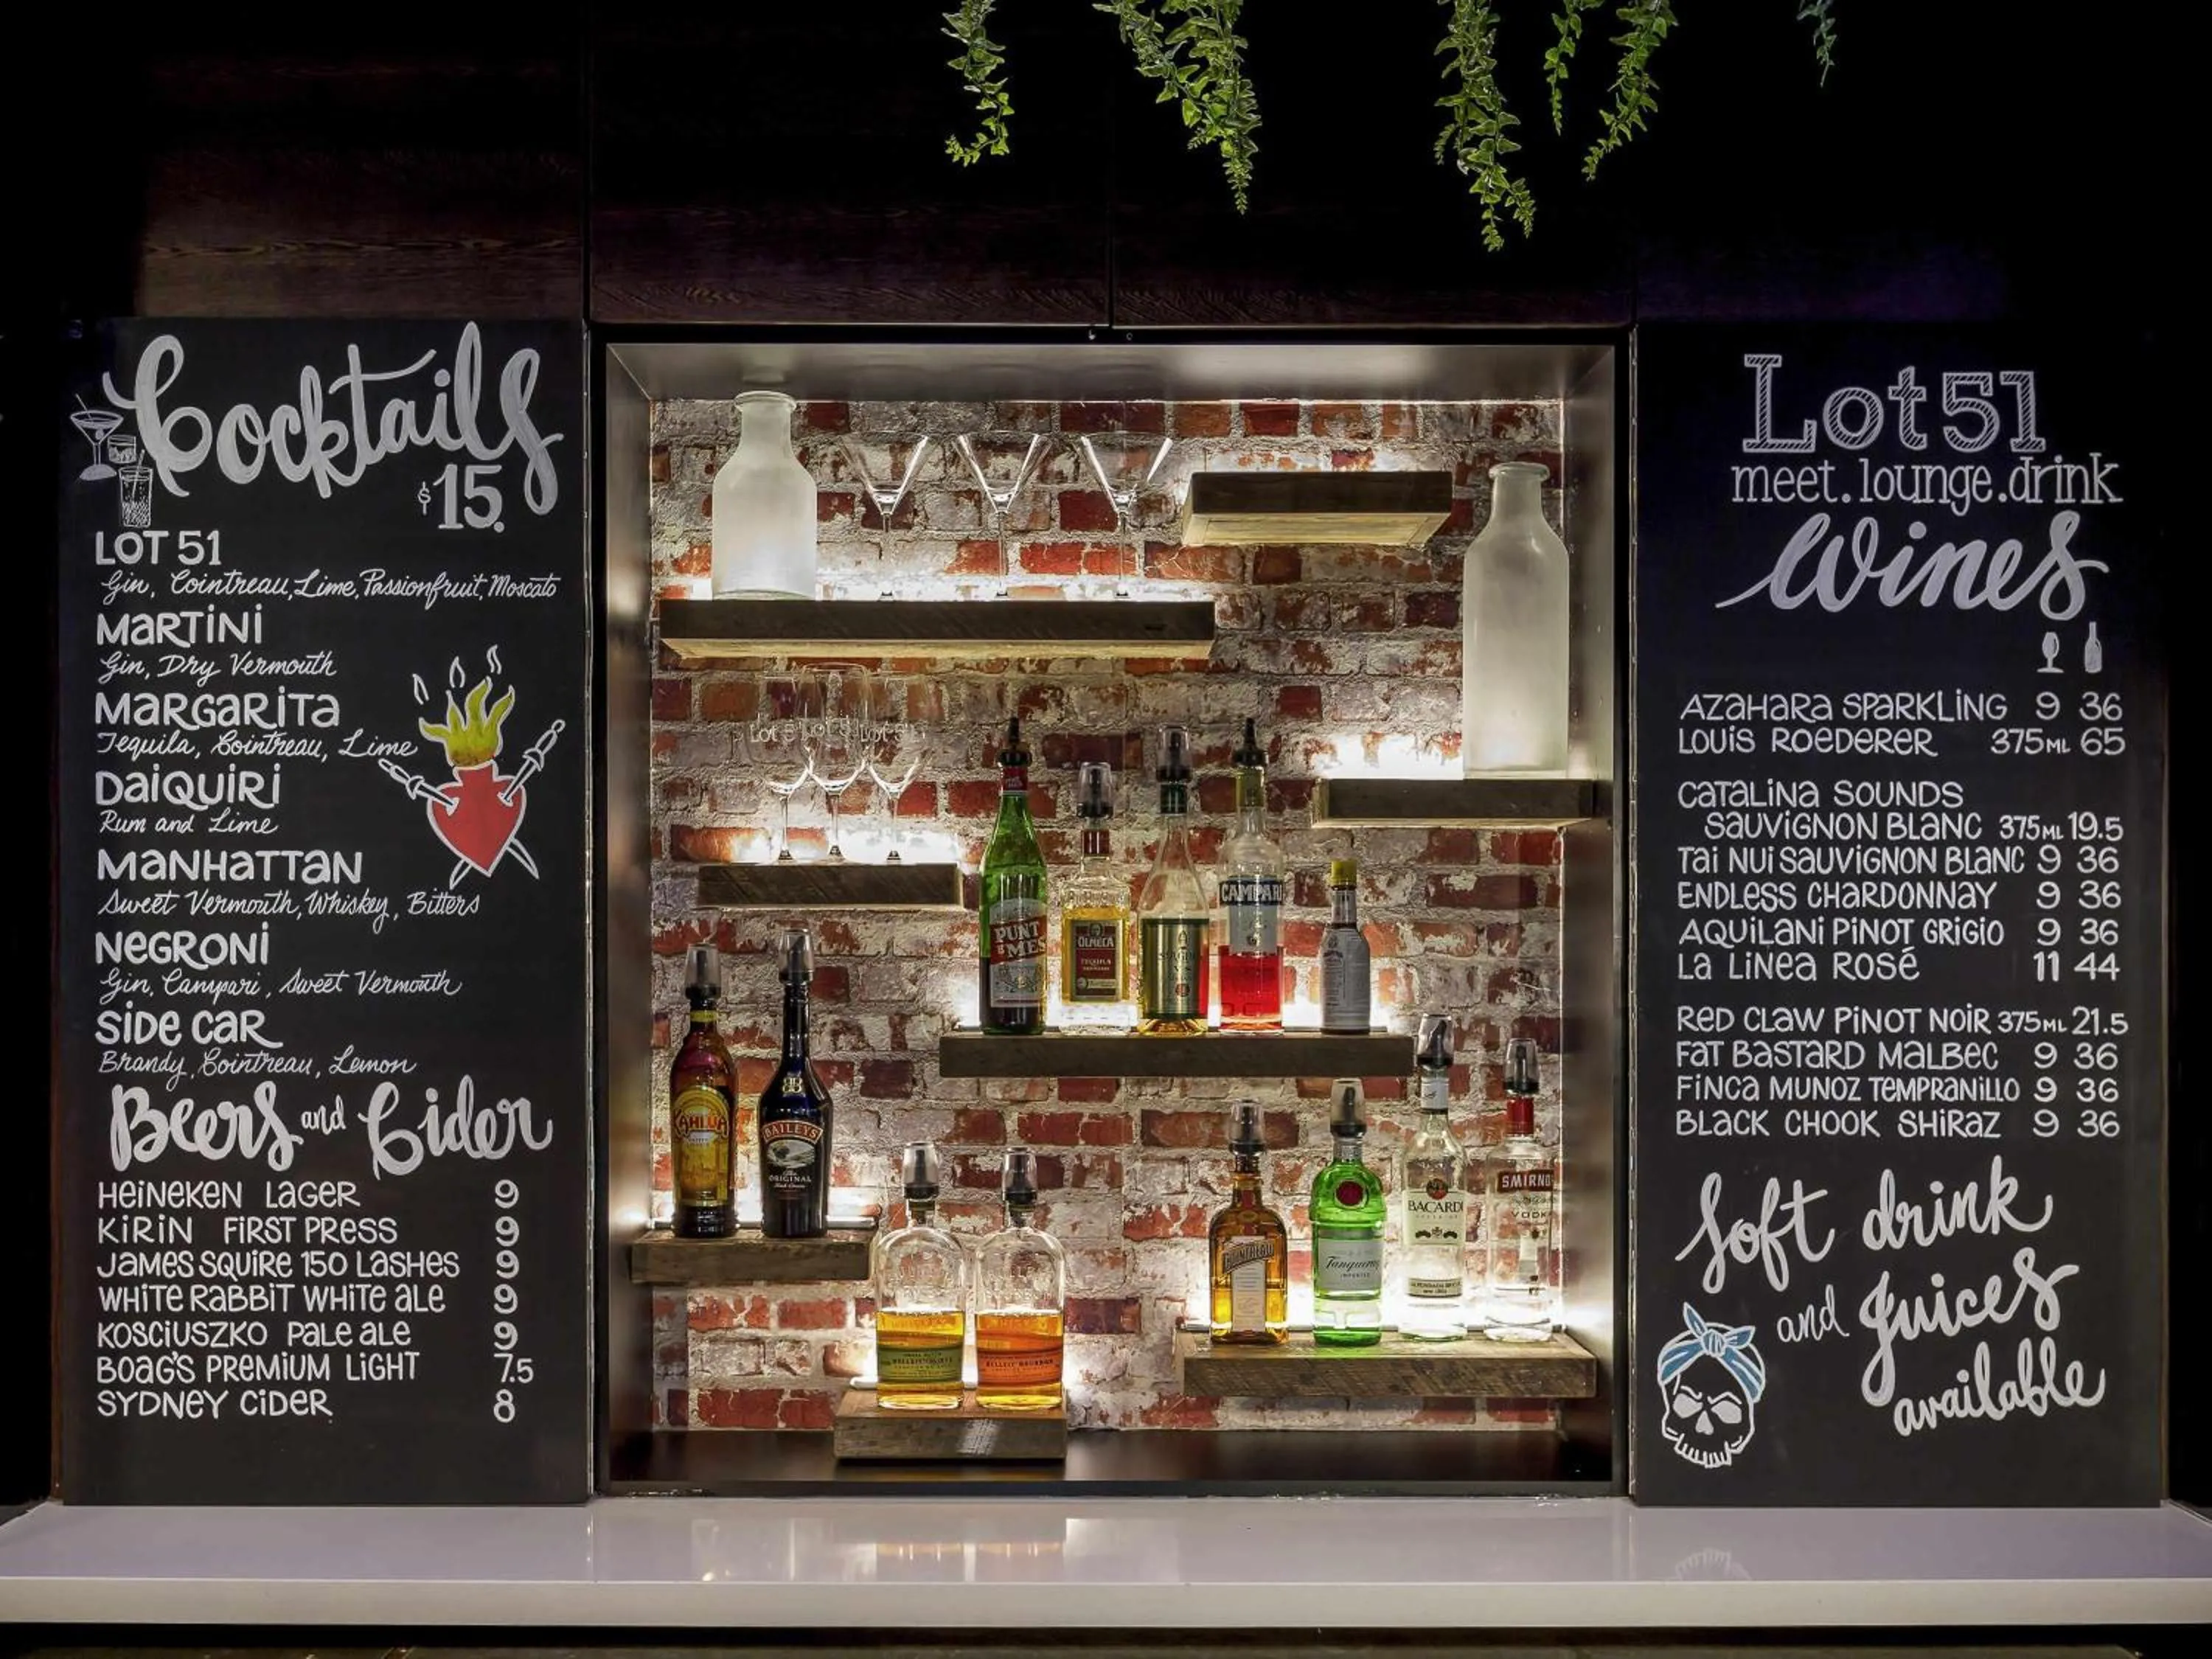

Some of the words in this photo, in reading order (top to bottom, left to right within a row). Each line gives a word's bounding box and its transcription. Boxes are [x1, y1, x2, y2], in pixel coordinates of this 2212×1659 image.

[103, 321, 563, 515] Cocktails
[1743, 354, 1927, 453] Lot
[1943, 372, 2045, 452] 51
[96, 531, 169, 565] LOT
[178, 530, 221, 565] 51
[1716, 511, 2108, 620] Wines
[102, 570, 155, 605] Gin,
[488, 574, 560, 598] Moscato
[98, 651, 150, 684] Gin,
[157, 655, 221, 687] Dry
[230, 651, 336, 676] Vermouth
[2037, 692, 2059, 720] 9
[2079, 692, 2122, 720] 36
[97, 729, 201, 761] Tequila,
[338, 728, 418, 757] Lime
[2081, 727, 2125, 755] 65
[1834, 780, 1963, 808] SOUNDS
[100, 810, 146, 833] Rum
[155, 814, 195, 834] and
[209, 807, 279, 834] Lime
[2068, 812, 2124, 841] 19.5
[2037, 844, 2061, 874] 9
[2077, 845, 2119, 873] 36
[98, 888, 180, 914] Sweet
[184, 888, 302, 920] Vermouth,
[407, 891, 479, 916] Bitters
[2037, 881, 2060, 909] 9
[2079, 880, 2121, 908] 36
[995, 921, 1040, 943] PUNT
[1007, 936, 1046, 958] MES
[2037, 918, 2061, 946] 9
[2080, 918, 2118, 945] 36
[2034, 951, 2059, 981] 11
[2074, 952, 2121, 981] 44
[100, 967, 153, 1004] Gin,
[279, 967, 349, 994] Sweet
[355, 970, 462, 995] Vermouth
[2072, 1006, 2129, 1036] 21.5
[329, 1045, 417, 1074] Lemon
[2034, 1042, 2057, 1068] 9
[2073, 1042, 2118, 1070] 36
[1770, 1076, 1861, 1101] MUNOZ
[2034, 1077, 2057, 1102] 9
[2076, 1078, 2118, 1102] 36
[111, 1081, 304, 1172] Beers
[301, 1095, 346, 1135] and
[358, 1075, 553, 1180] Cider
[764, 1122, 818, 1139] BAILEYS
[1785, 1110, 1880, 1137] CHOOK
[2033, 1109, 2059, 1137] 9
[2077, 1110, 2120, 1137] 36
[495, 1180, 519, 1208] 9
[769, 1175, 812, 1183] ORIGINAL
[495, 1217, 519, 1247] 9
[1675, 1172, 1834, 1293] Soft
[1863, 1155, 2053, 1251] drink
[301, 1251, 348, 1277] 150
[496, 1250, 519, 1279] 9
[494, 1284, 518, 1314] 9
[1777, 1284, 1849, 1342] and
[494, 1321, 518, 1350] 9
[494, 1353, 533, 1383] 7.5
[1893, 1336, 2105, 1436] available
[493, 1389, 515, 1423] 8
